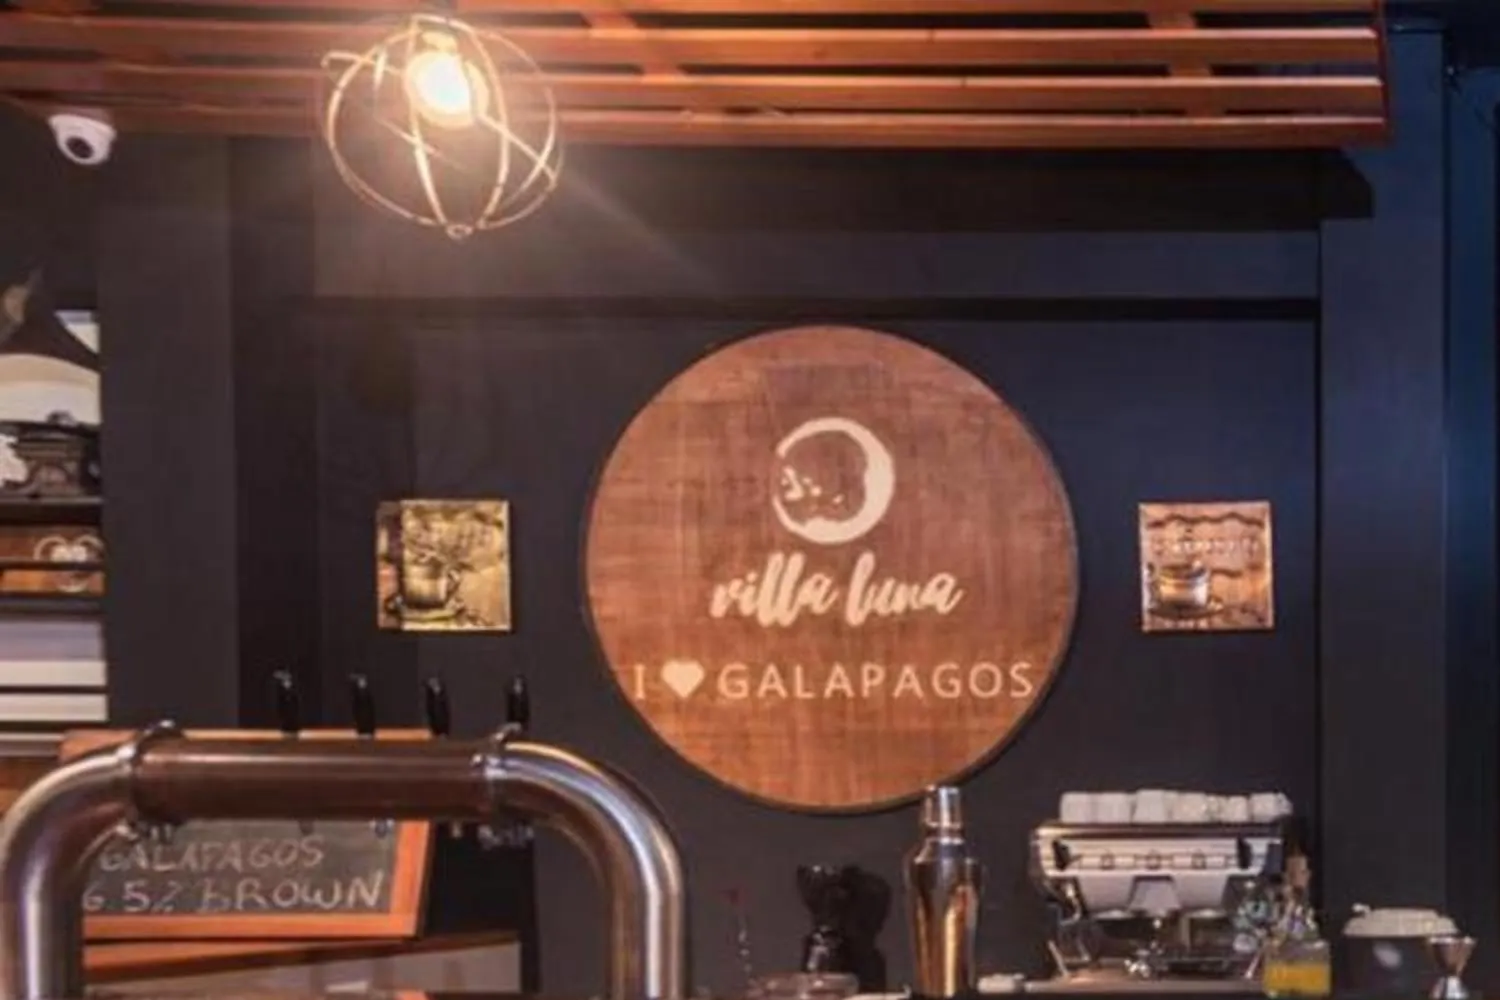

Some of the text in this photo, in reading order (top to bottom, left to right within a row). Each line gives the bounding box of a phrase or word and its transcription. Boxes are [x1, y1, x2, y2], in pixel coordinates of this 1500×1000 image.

[709, 551, 964, 627] villa luna
[633, 662, 1033, 699] I GALAPAGOS
[198, 871, 384, 913] BROWN
